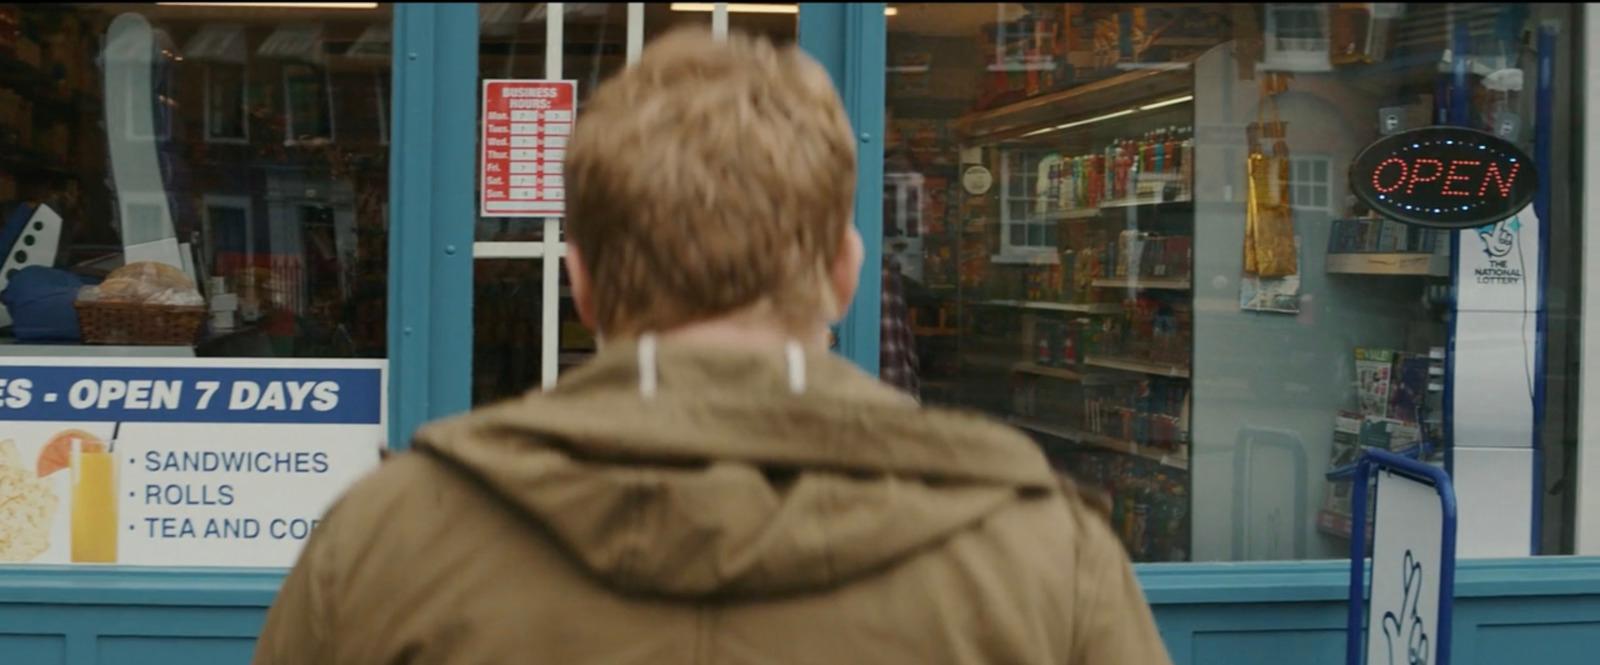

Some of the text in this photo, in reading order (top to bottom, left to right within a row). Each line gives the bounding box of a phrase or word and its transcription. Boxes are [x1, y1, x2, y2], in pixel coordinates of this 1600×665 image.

[502, 87, 557, 98] BUSINESS
[1371, 157, 1521, 197] OPEN
[1474, 268, 1522, 277] NATIONAL
[1489, 260, 1507, 268] THE
[1476, 276, 1520, 285] LOTTERY
[68, 379, 182, 410] OPEN
[195, 381, 221, 410] 7
[228, 381, 340, 412] DAYS
[144, 451, 329, 473] SANDWICHES
[145, 485, 235, 505] ROLLS
[145, 518, 196, 539] TEA
[203, 518, 260, 539] AND
